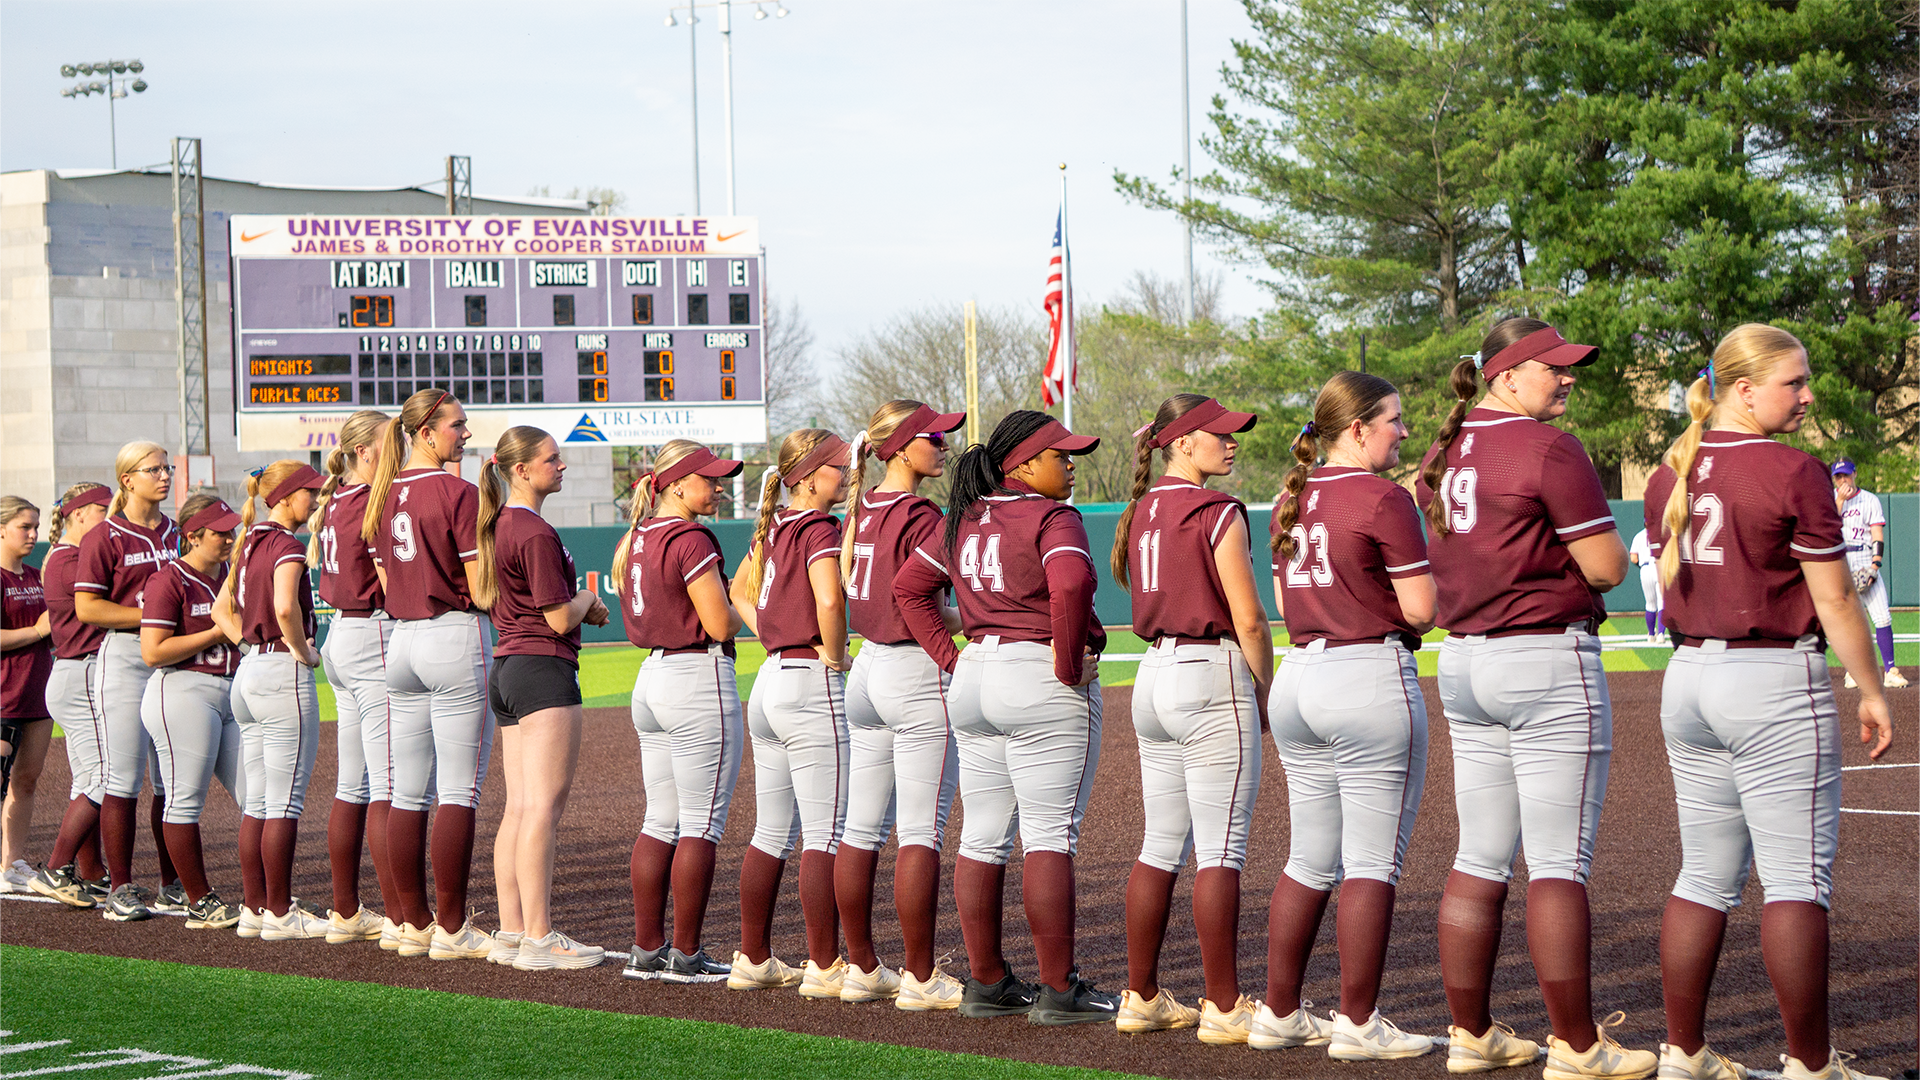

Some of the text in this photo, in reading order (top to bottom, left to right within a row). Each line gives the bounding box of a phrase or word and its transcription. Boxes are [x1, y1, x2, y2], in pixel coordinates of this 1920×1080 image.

[288, 219, 708, 237] UNIVERSITY OF EVANSVILLE
[292, 240, 705, 253] JAMES & DOROTHY COOPER STADIUM
[338, 261, 401, 288] AT BAT
[451, 261, 499, 287] BALL
[536, 262, 587, 286] STRIKE
[626, 261, 656, 285] OUT
[691, 261, 704, 286] H
[732, 261, 744, 285] E
[353, 295, 393, 327] 20
[362, 335, 541, 351] 1 2 3 4 5 6 7 8 9 10
[577, 334, 607, 349] RUNS
[646, 333, 671, 348] HITS
[706, 333, 747, 348] ERRORS
[250, 360, 313, 375] KNIGHTS
[594, 352, 608, 375] 0
[659, 351, 673, 374] 0
[721, 350, 735, 373] 0
[251, 387, 340, 403] PURPLE ACES
[722, 377, 735, 400] 0
[600, 411, 696, 425] TRI-STATE
[688, 428, 715, 436] FIELD
[1440, 467, 1477, 533] 19
[391, 511, 417, 562] 9
[960, 534, 1005, 592] 44
[1138, 529, 1161, 593] 11
[1287, 523, 1334, 588] 23
[847, 542, 875, 600] 27
